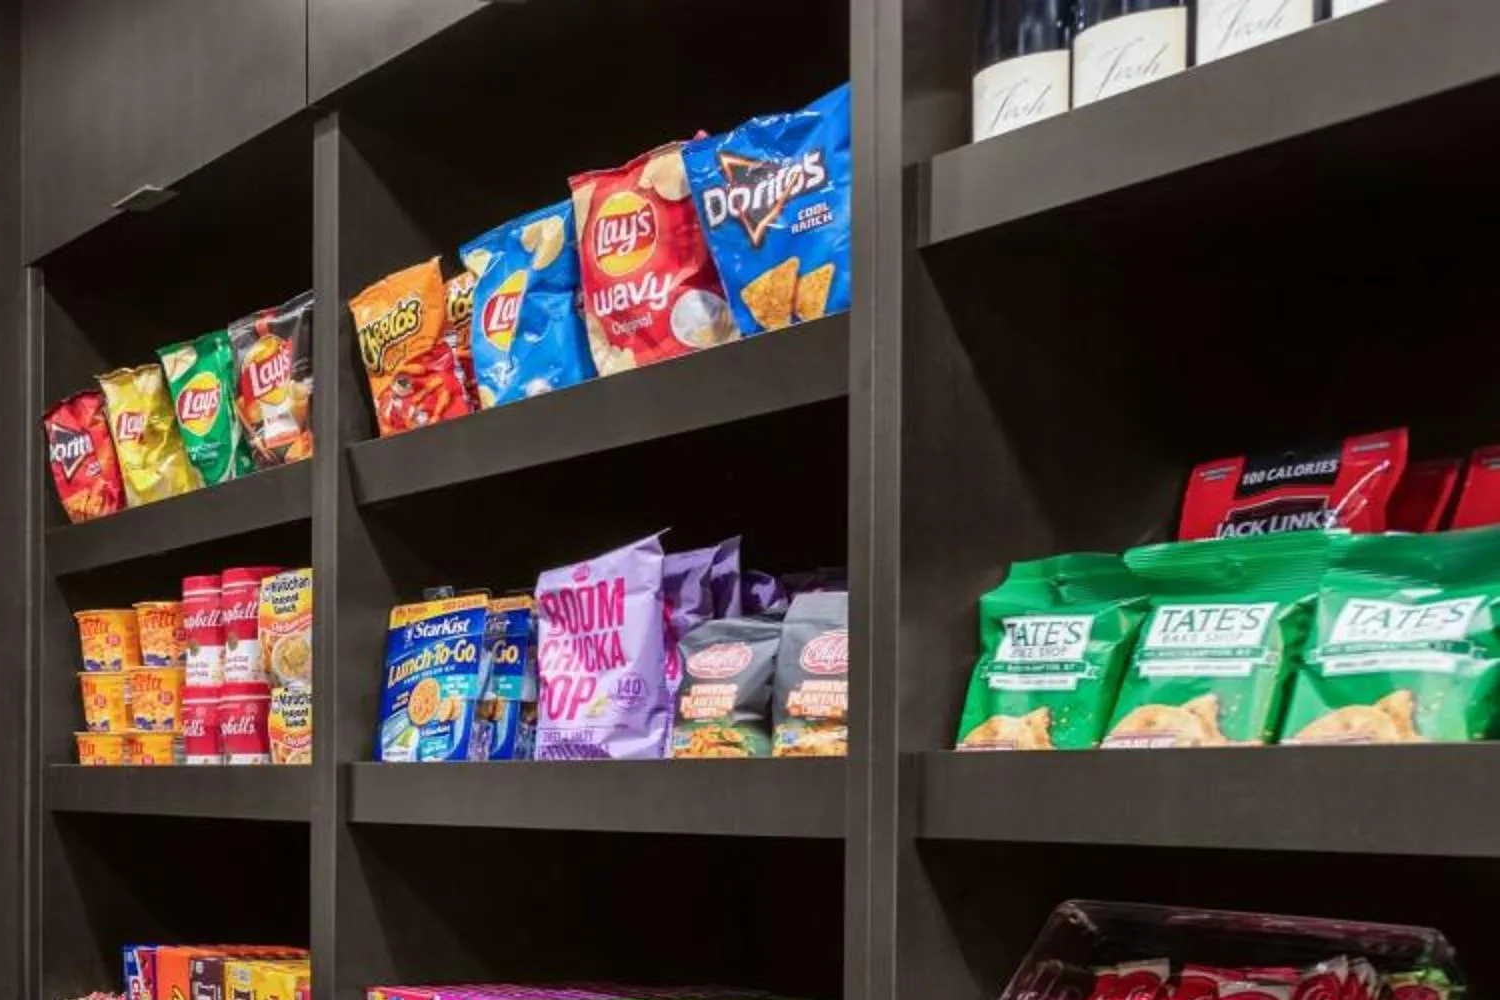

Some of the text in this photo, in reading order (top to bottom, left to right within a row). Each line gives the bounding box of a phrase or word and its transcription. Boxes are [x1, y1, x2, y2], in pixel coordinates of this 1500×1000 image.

[703, 150, 826, 228] Doritos
[597, 206, 652, 256] Lay's
[791, 212, 834, 235] RANCH
[593, 270, 676, 317] wavy
[1266, 458, 1340, 481] CALORIES
[540, 576, 626, 633] BOOM
[1160, 606, 1267, 633] TATE'S
[414, 616, 471, 639] StarKist
